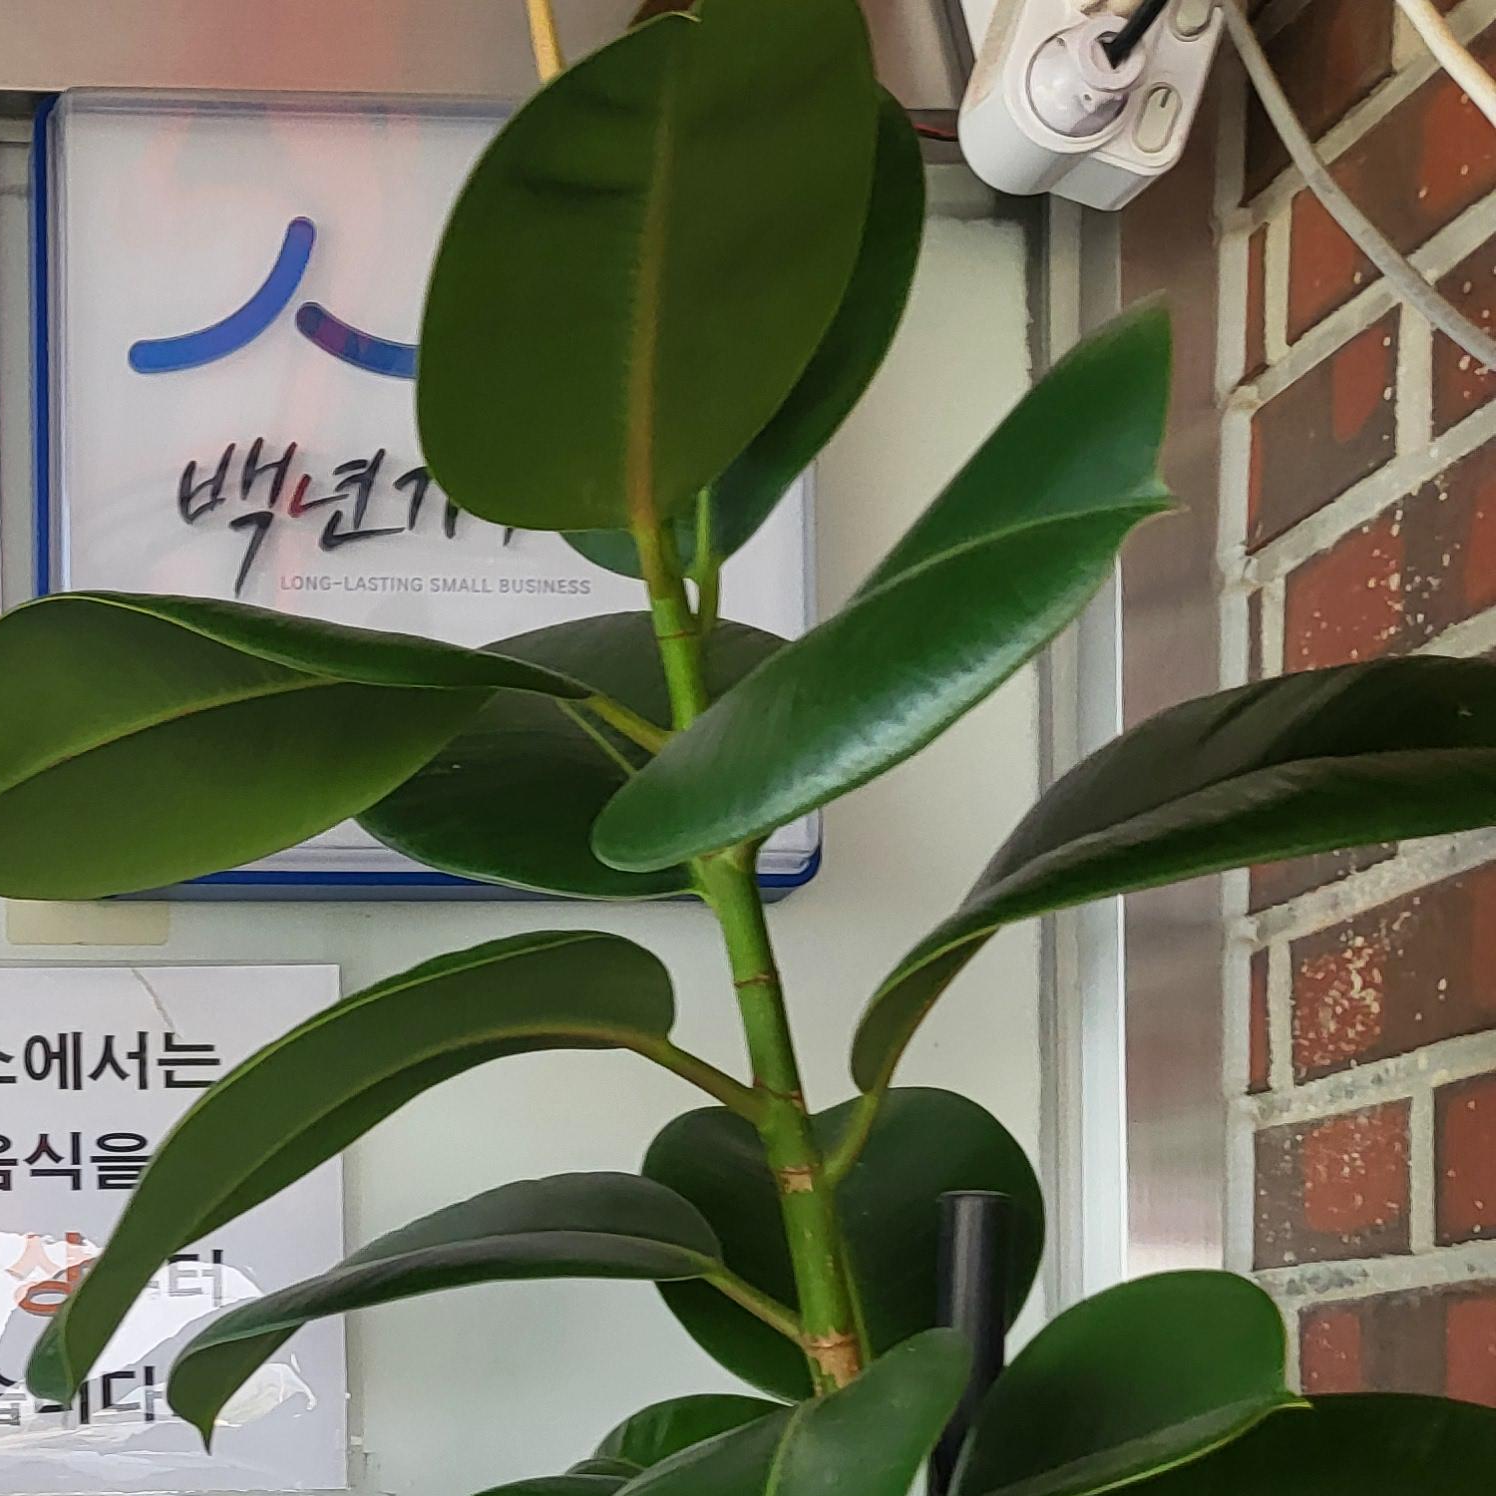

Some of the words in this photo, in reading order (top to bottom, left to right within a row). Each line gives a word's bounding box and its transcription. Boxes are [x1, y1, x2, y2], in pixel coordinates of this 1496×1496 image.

[280, 575, 424, 594] LONG-LASTING
[430, 577, 492, 595] SMALL
[499, 578, 592, 597] BUSINESS
